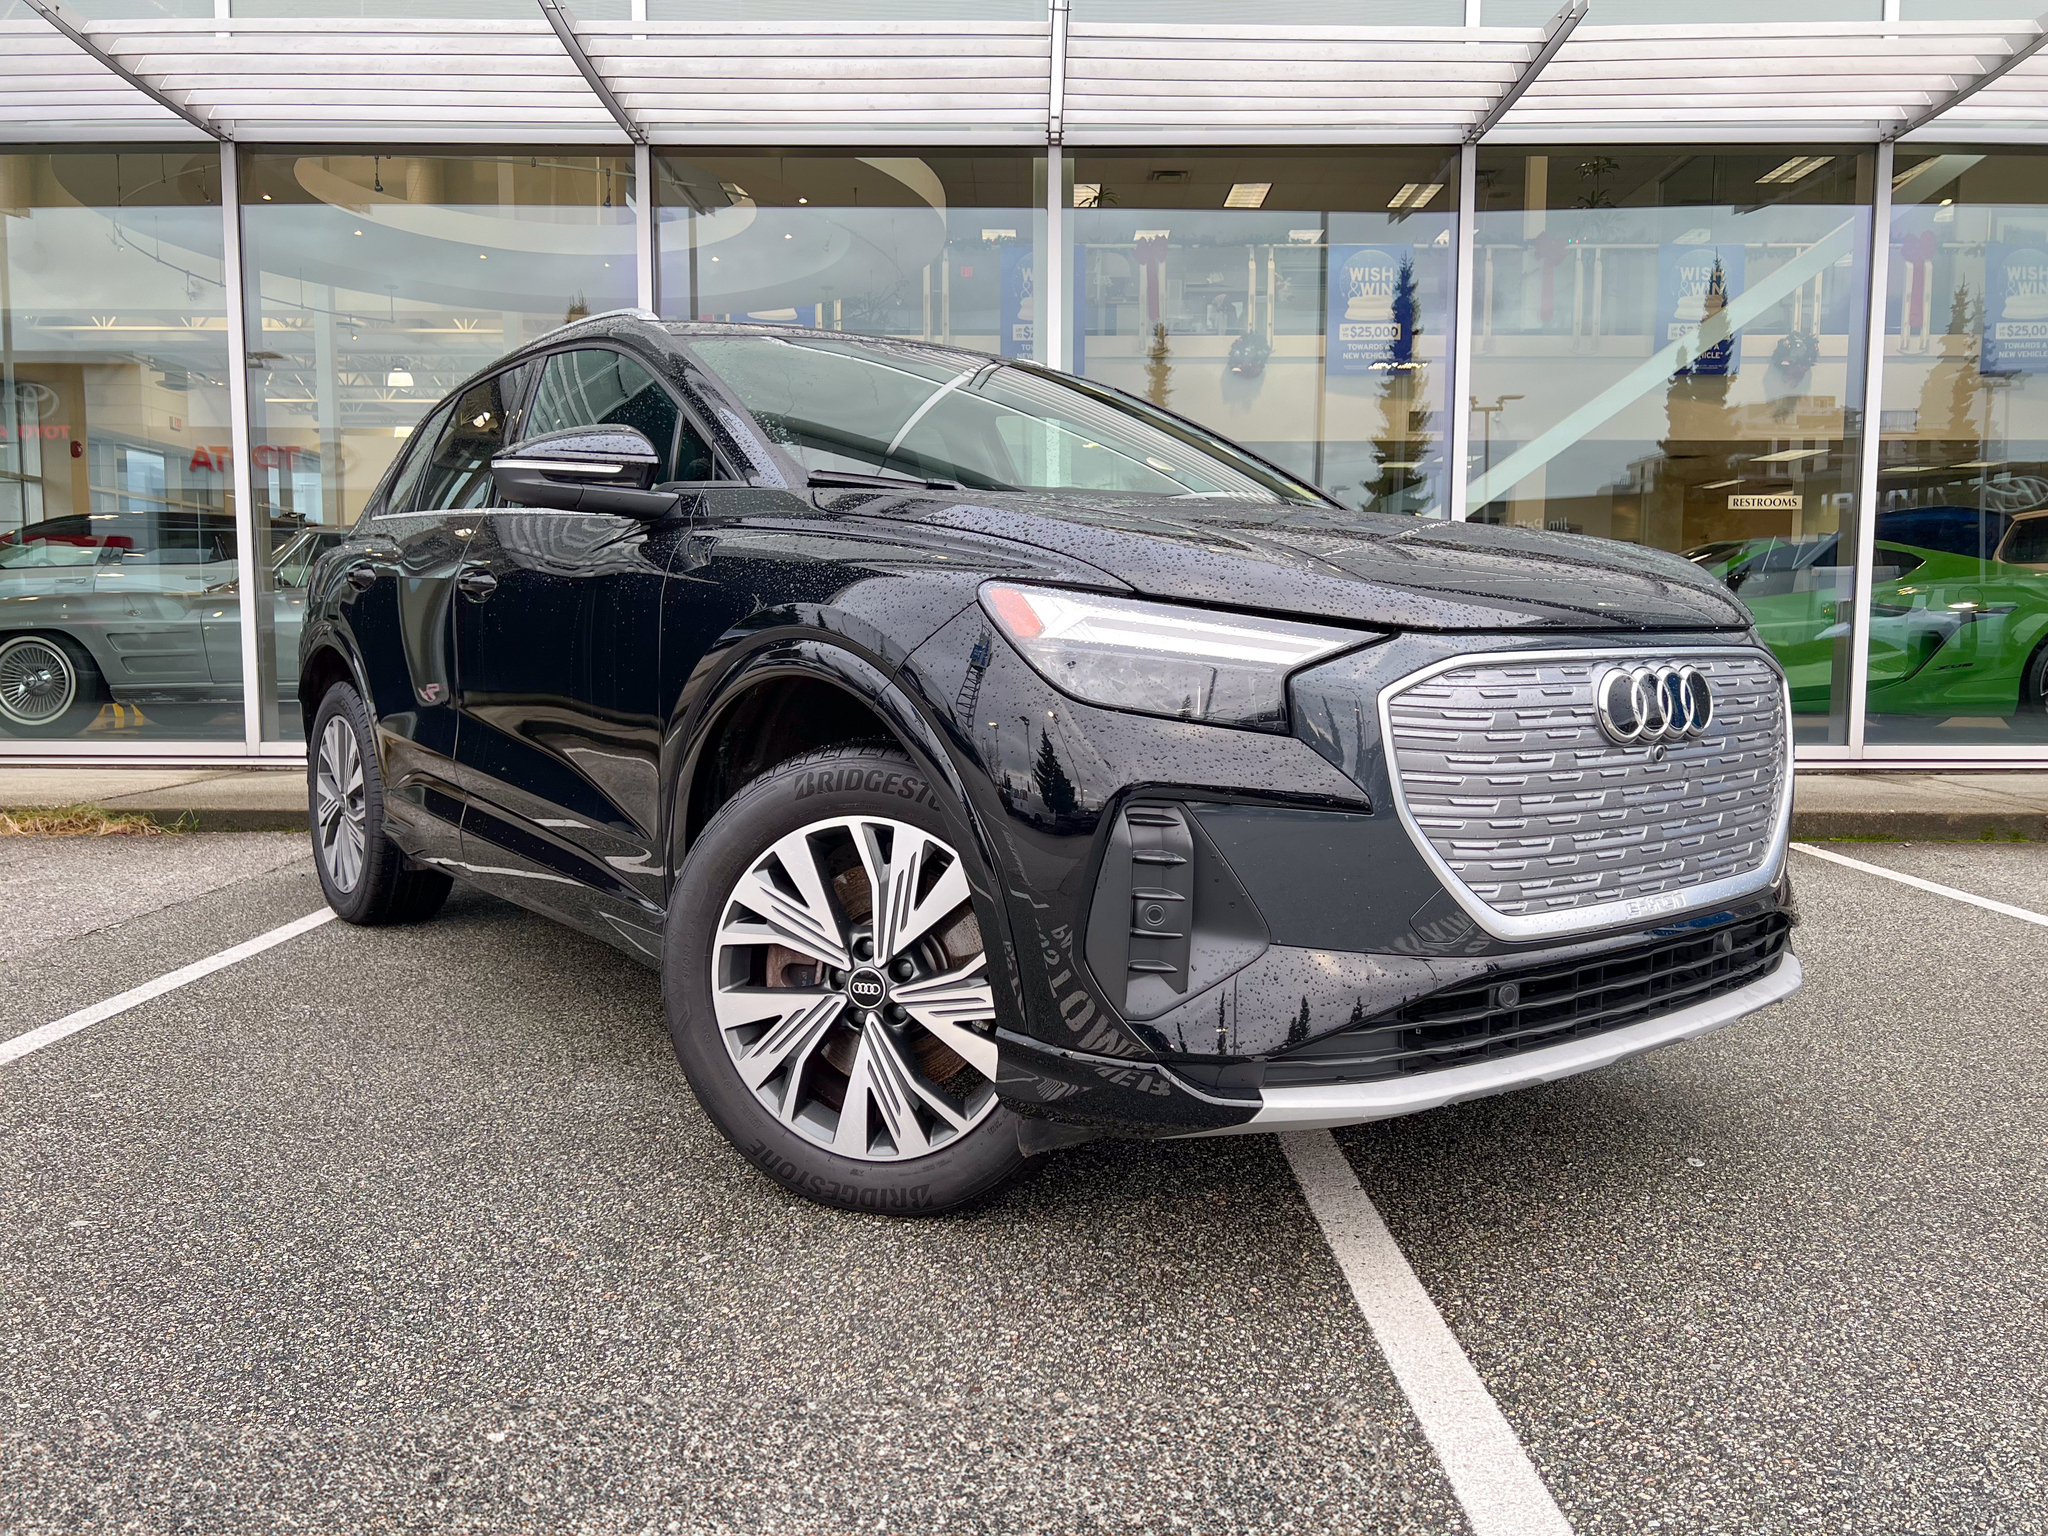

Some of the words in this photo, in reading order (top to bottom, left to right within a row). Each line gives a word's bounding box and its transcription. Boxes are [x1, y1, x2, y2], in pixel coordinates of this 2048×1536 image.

[1349, 267, 1394, 281] WISH
[1360, 282, 1393, 297] WIN
[1350, 325, 1399, 340] $25,000
[2007, 324, 2047, 338] $25,00
[2004, 342, 2041, 350] TOWARDS
[1342, 352, 1360, 360] NEW
[1999, 351, 2018, 359] NEW
[1732, 497, 1797, 508] RESTROOMS
[746, 1138, 936, 1211] BRIDGESTONE
